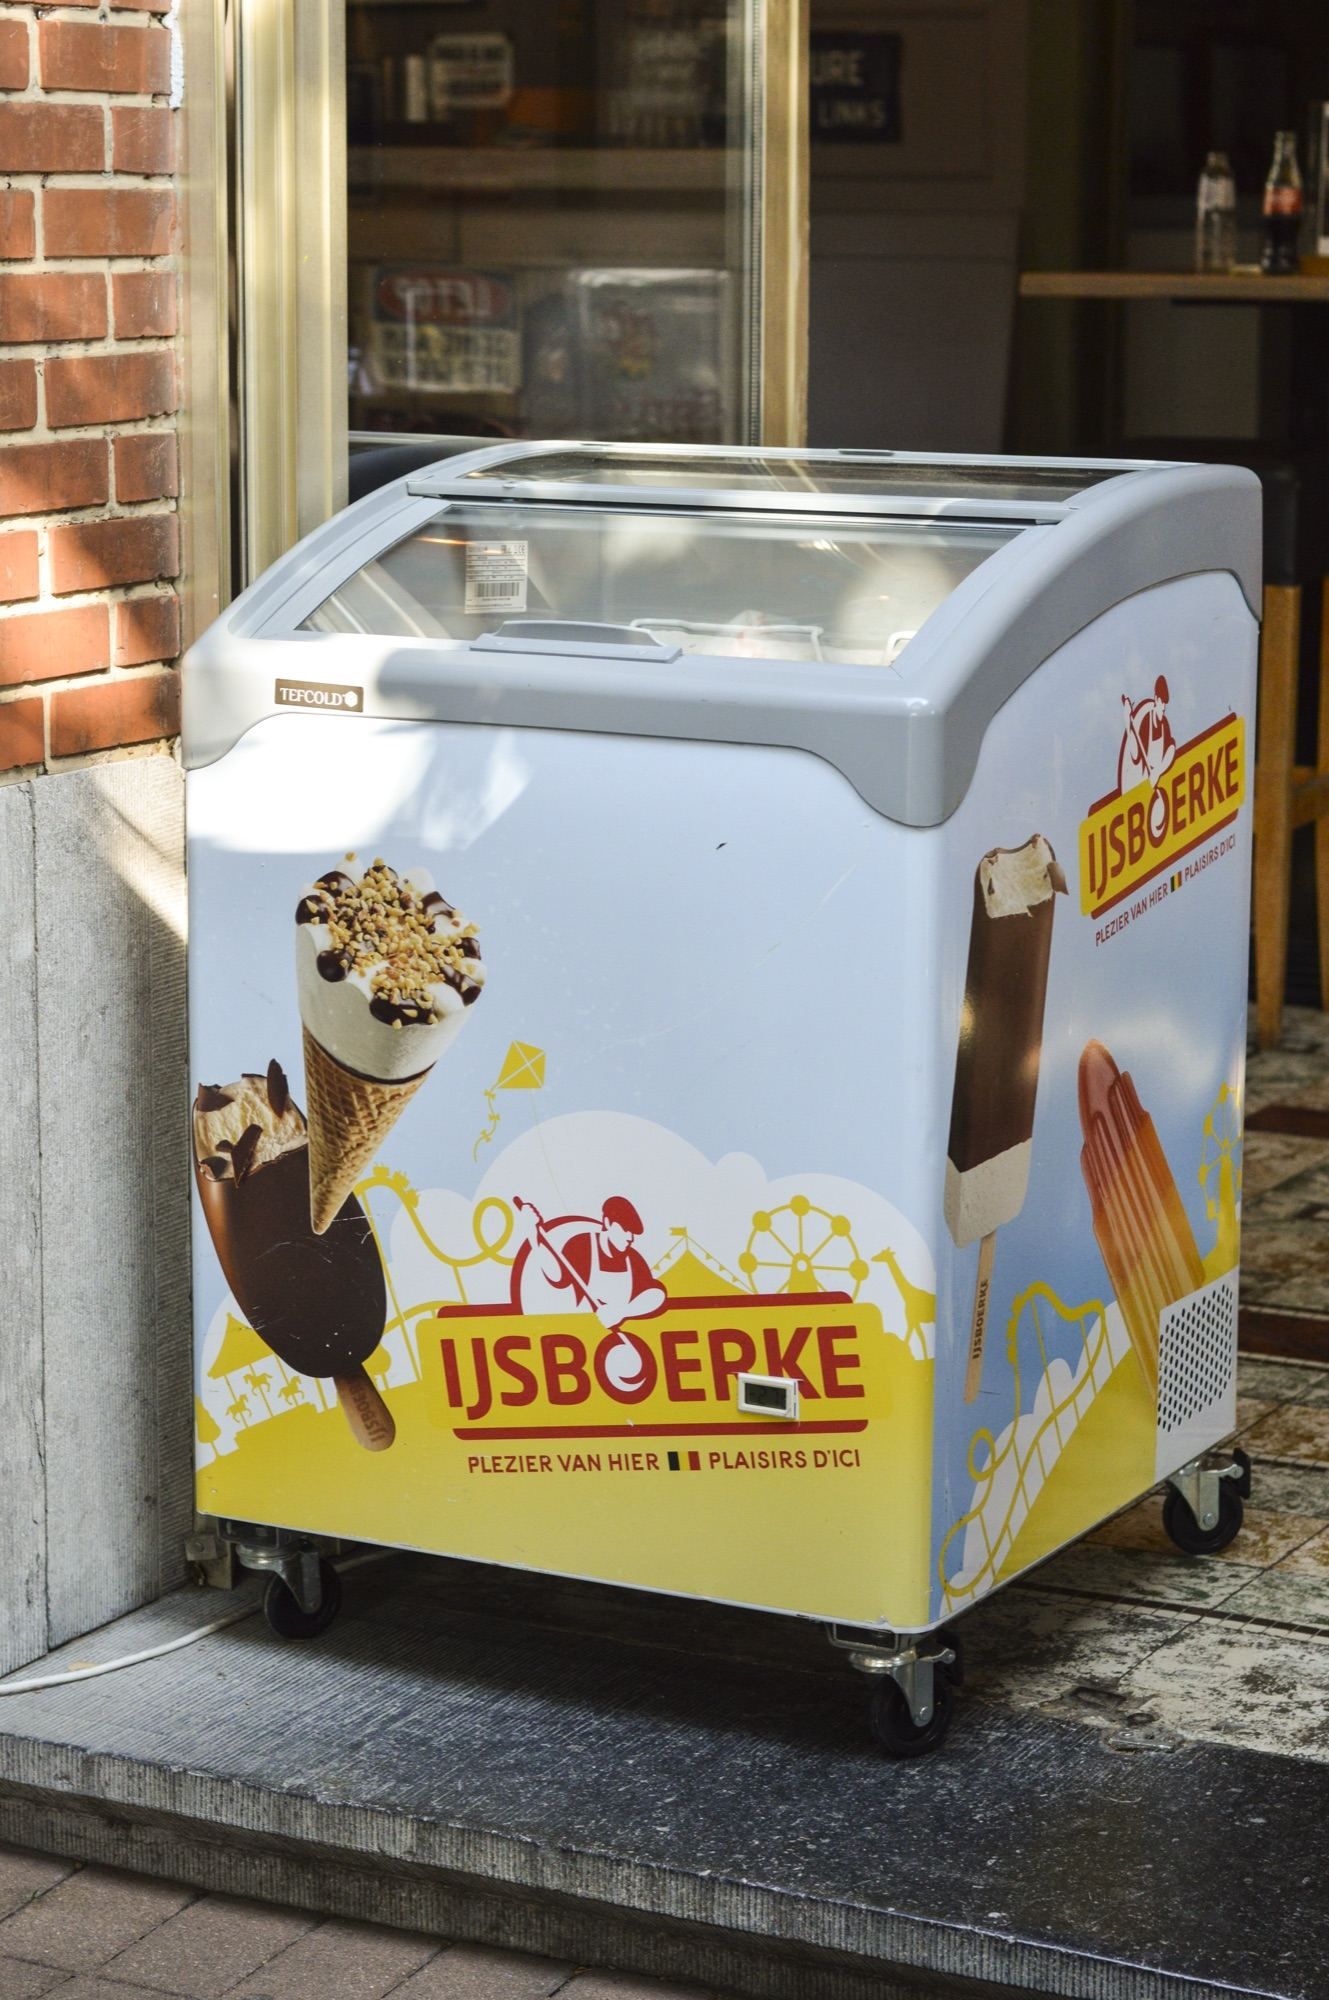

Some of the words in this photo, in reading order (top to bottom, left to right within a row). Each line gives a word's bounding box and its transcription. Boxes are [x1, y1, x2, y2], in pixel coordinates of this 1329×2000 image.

[280, 687, 342, 706] TEFCOLD
[1088, 737, 1239, 901] IJSBOERKE
[1095, 911, 1129, 947] PLEZIER
[1131, 897, 1147, 920] VAN
[1149, 882, 1168, 908] HIER
[1184, 846, 1219, 881] PLAISIRS
[440, 1325, 865, 1421] IJSBOERKE
[467, 1455, 553, 1475] PLEZIER
[556, 1454, 601, 1473] VAN
[608, 1453, 660, 1472] HIER
[708, 1450, 808, 1471] PLAISIRS
[813, 1449, 861, 1468] D'ICI
